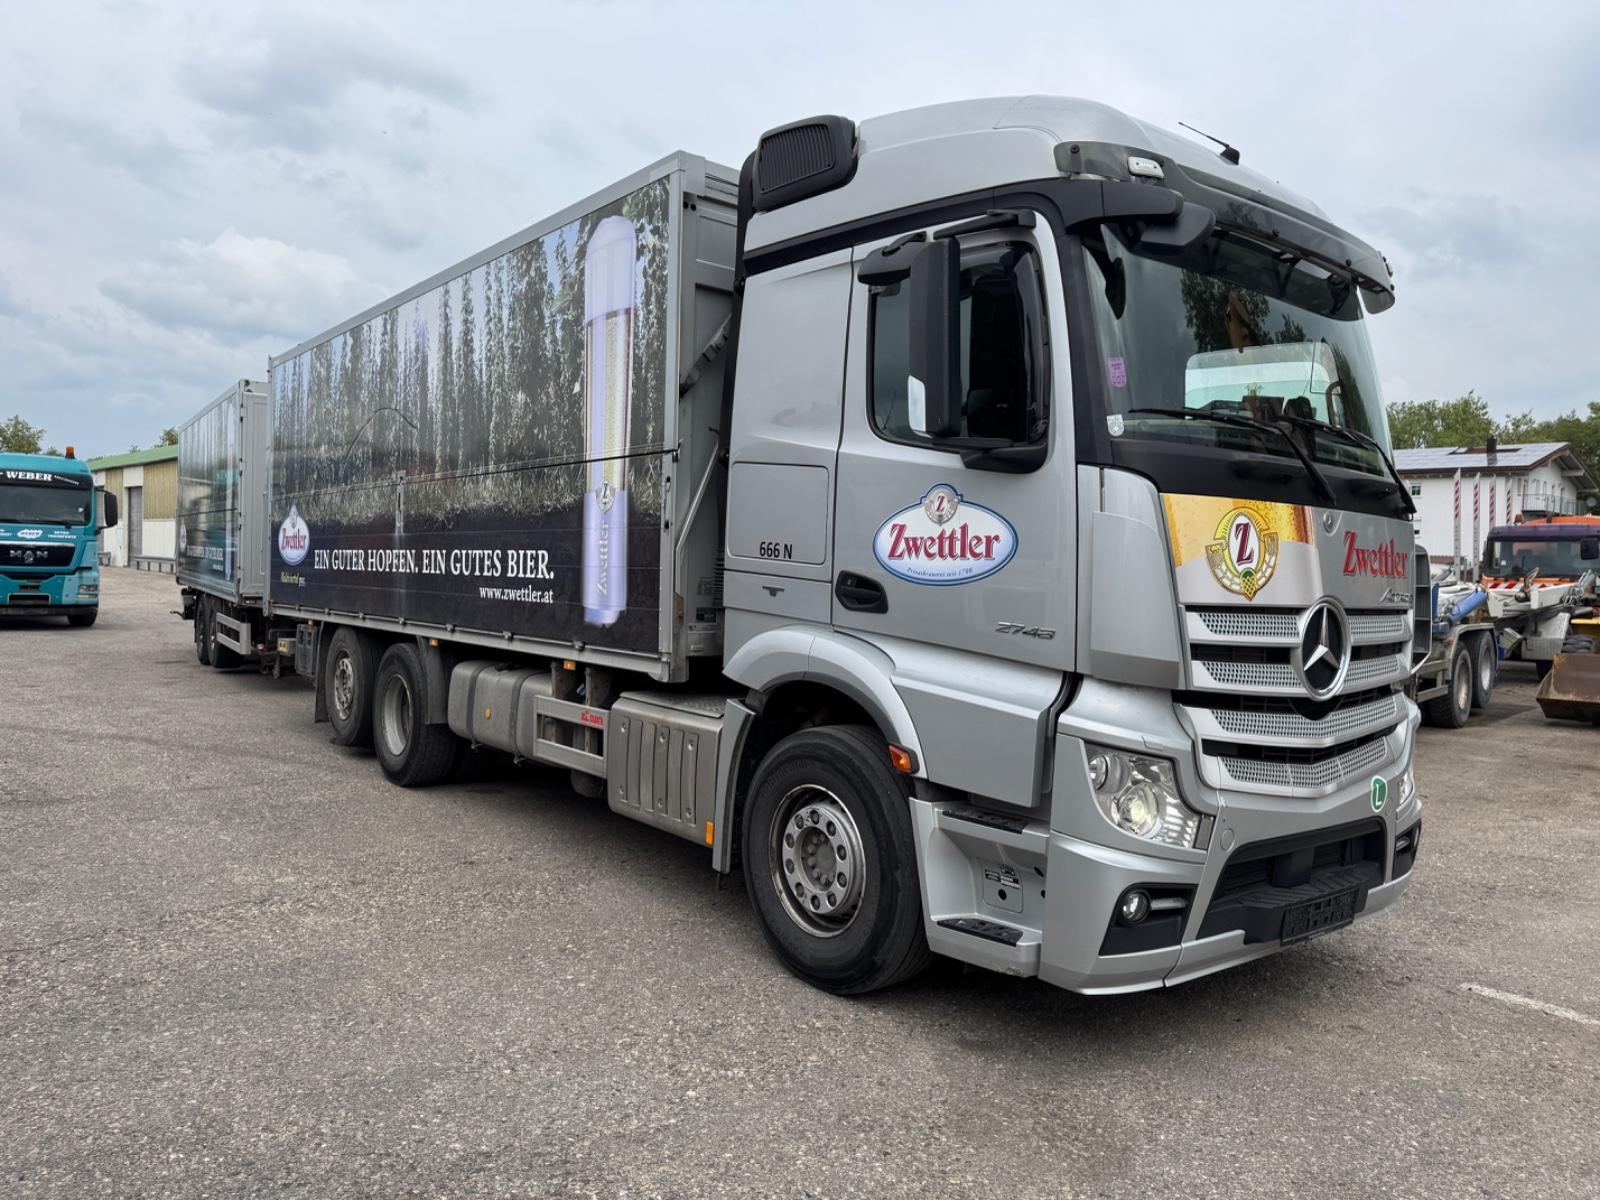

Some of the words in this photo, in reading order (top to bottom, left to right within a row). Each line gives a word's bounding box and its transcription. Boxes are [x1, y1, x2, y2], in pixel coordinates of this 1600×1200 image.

[6, 471, 53, 481] WEBER
[936, 495, 945, 512] Z
[759, 541, 781, 558] 666
[783, 543, 793, 560] N
[887, 523, 1001, 561] Zwettler
[1235, 522, 1255, 566] Z
[10, 550, 48, 558] MAN
[1343, 530, 1408, 579] Zwettler
[314, 549, 329, 570] EIN
[331, 549, 365, 572] GUTER
[367, 549, 418, 573] HOPFEN.
[422, 549, 446, 575] EIN
[450, 549, 501, 577] GUTES
[506, 549, 554, 579] BIER.
[479, 585, 553, 603] www.zwettler.at
[995, 621, 1056, 640] 2743
